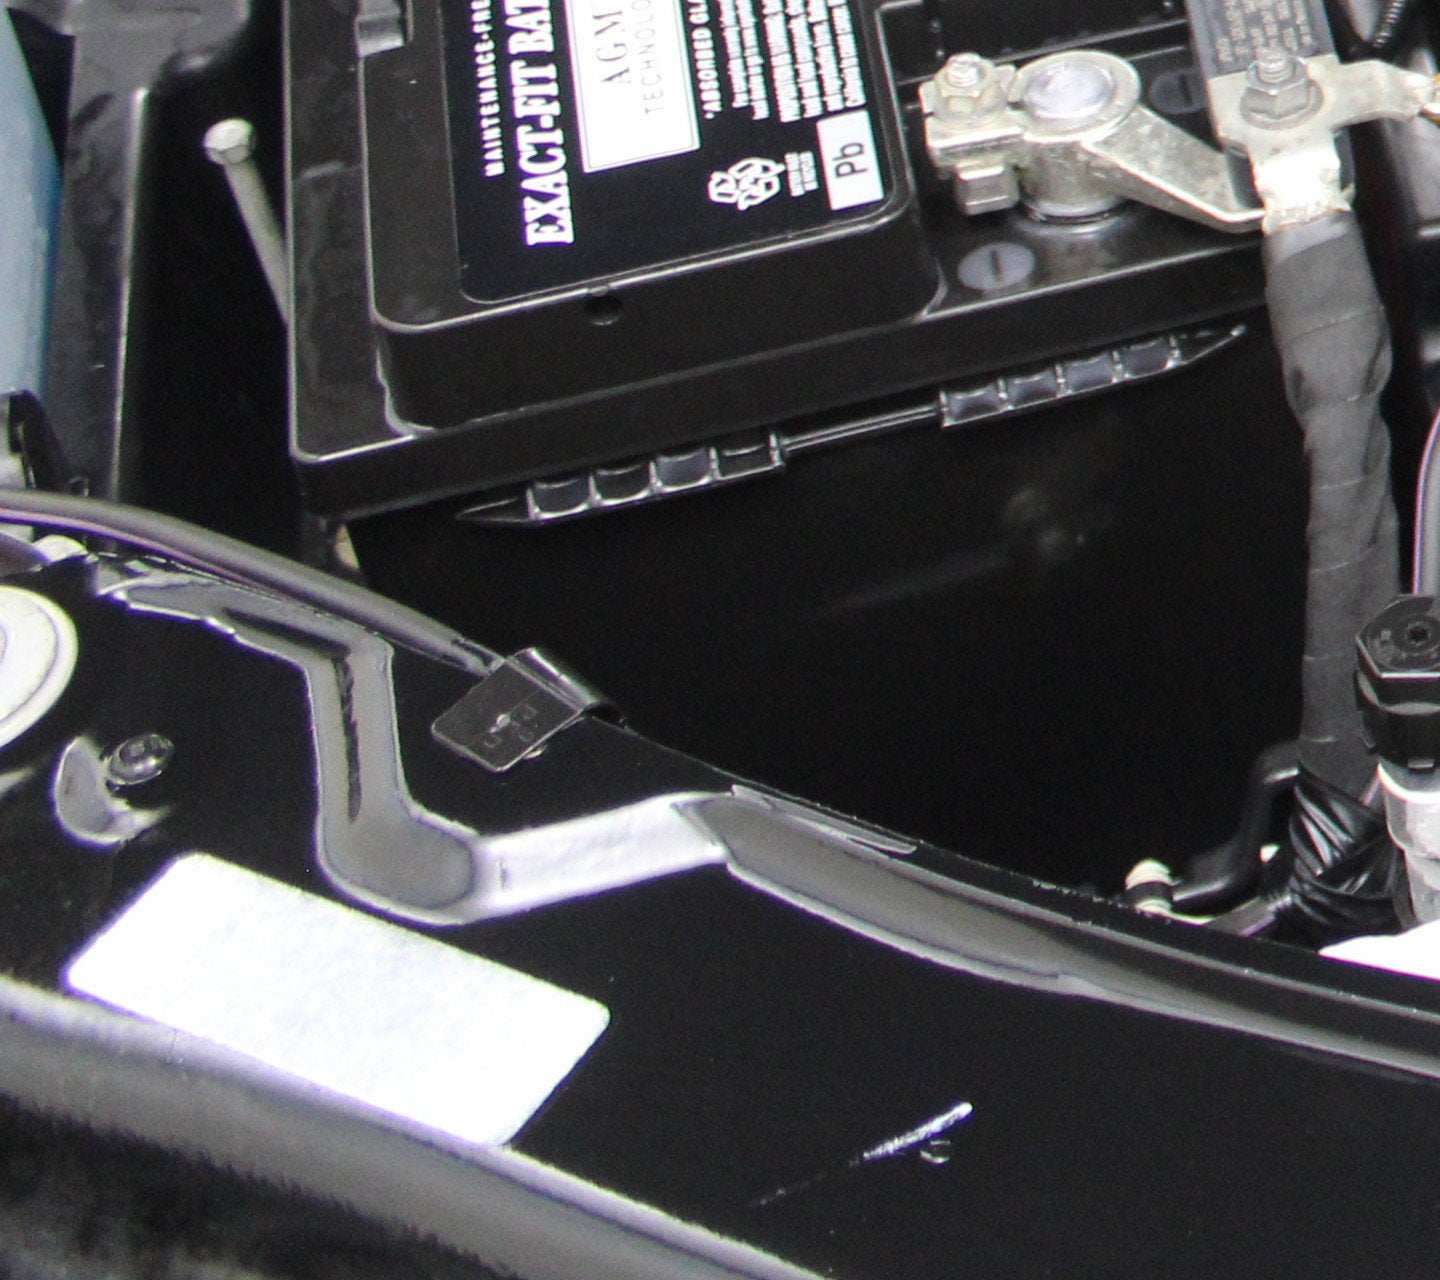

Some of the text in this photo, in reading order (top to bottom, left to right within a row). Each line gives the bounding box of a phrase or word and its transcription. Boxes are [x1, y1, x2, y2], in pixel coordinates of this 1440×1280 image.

[592, 8, 633, 86] AGM
[510, 60, 575, 247] EXACT-FIT
[833, 141, 869, 178] Pb
